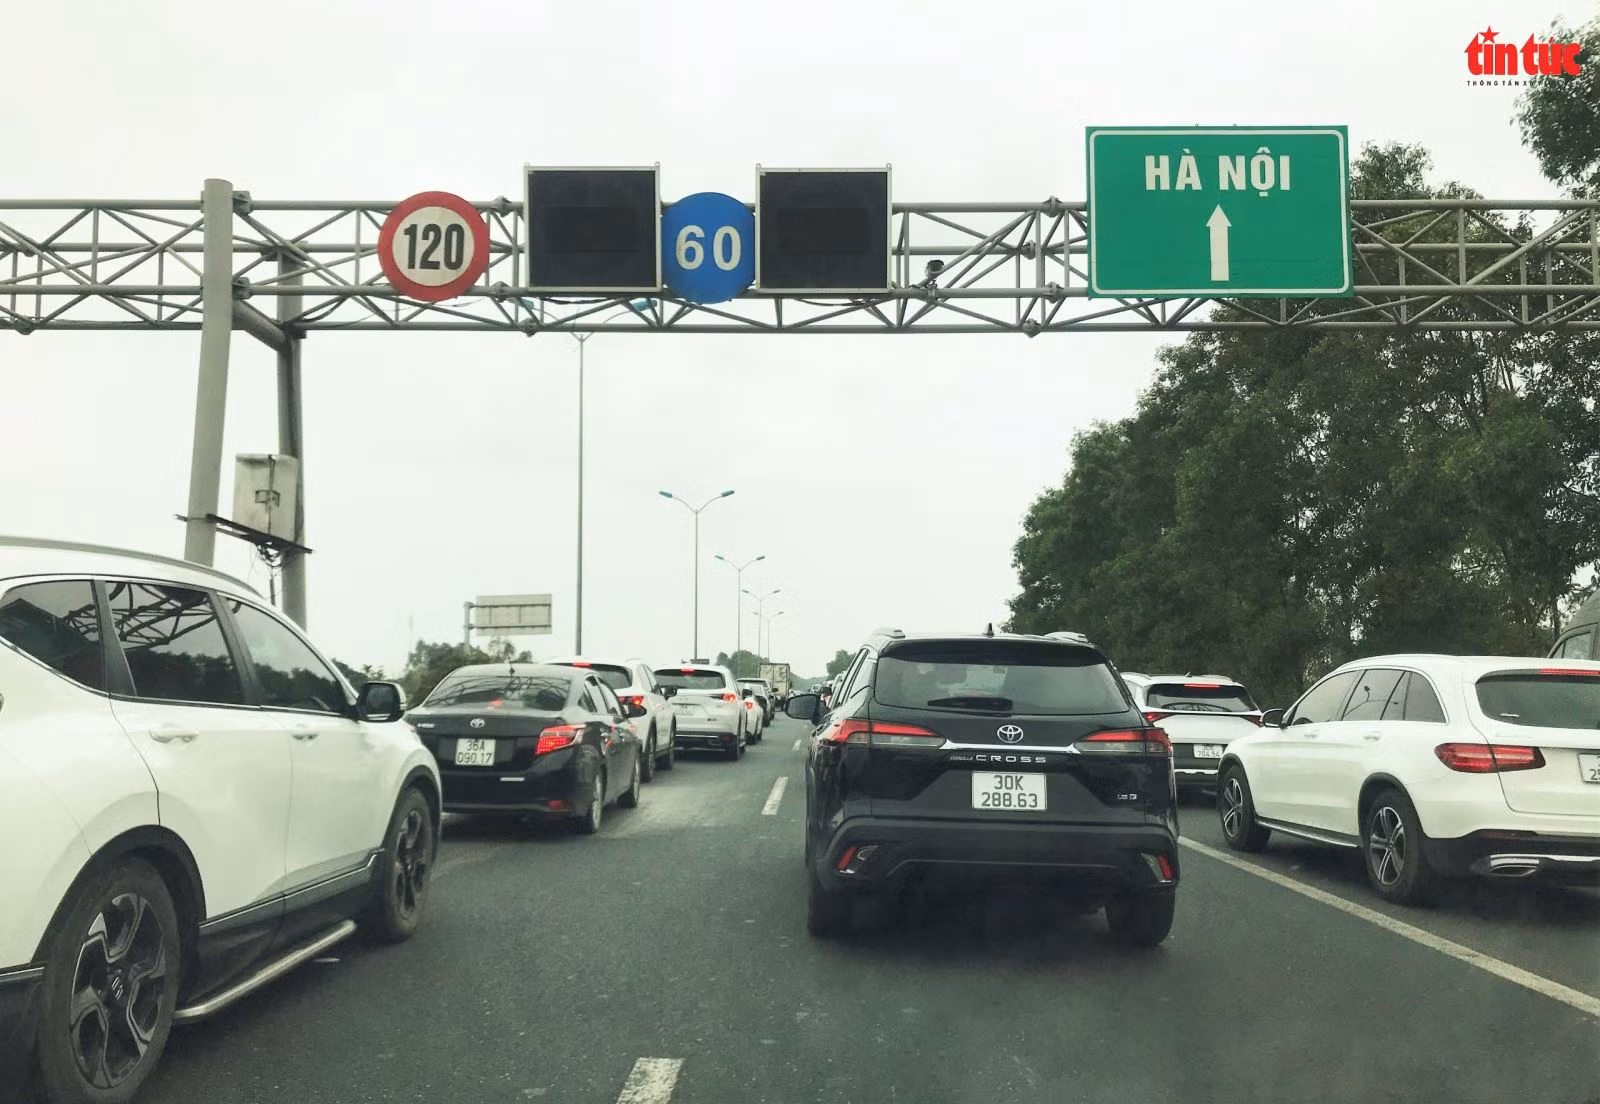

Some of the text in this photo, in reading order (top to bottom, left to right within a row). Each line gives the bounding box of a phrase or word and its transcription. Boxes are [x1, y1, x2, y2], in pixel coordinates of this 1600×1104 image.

[1144, 146, 1291, 197] HÀ NỘI
[403, 223, 465, 270] 120
[675, 225, 742, 271] 60
[467, 739, 485, 751] 36A
[457, 752, 492, 764] 090.17
[975, 754, 1046, 763] CROSS
[993, 775, 1024, 790] 30K
[981, 792, 1038, 808] 288.63
